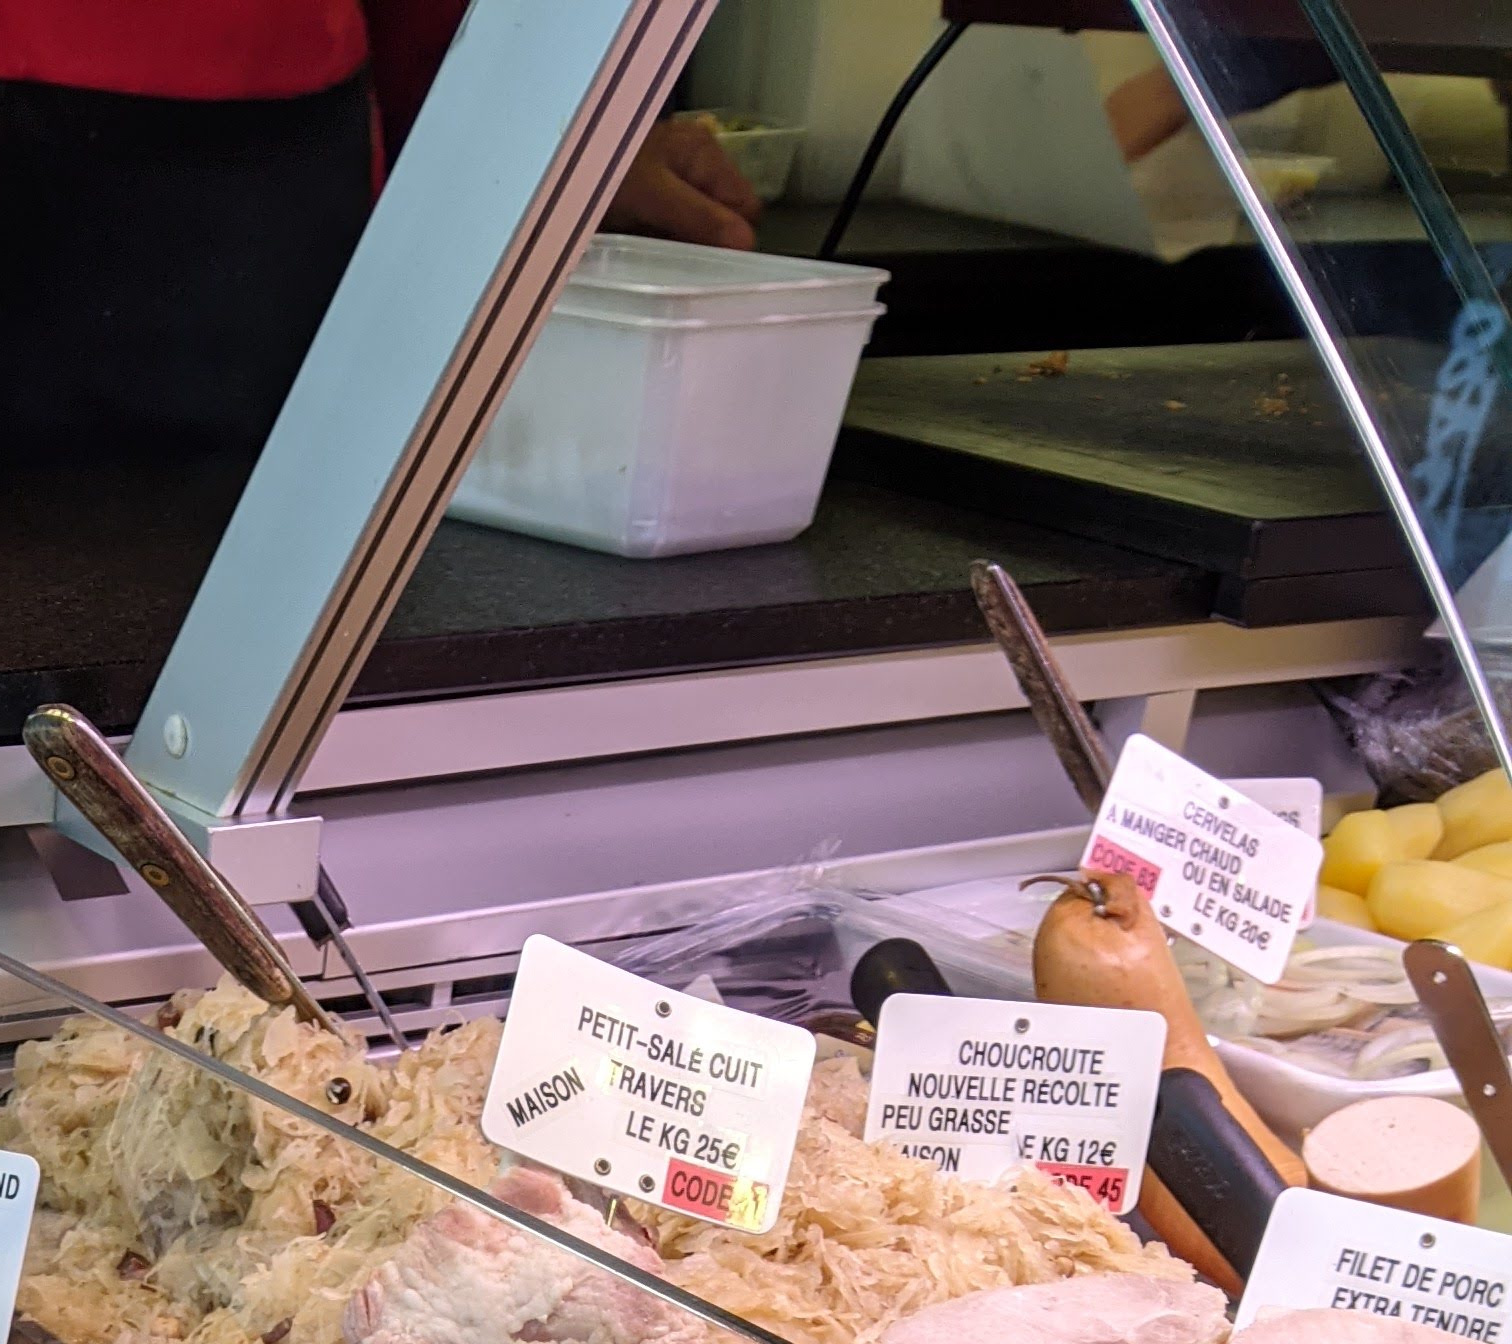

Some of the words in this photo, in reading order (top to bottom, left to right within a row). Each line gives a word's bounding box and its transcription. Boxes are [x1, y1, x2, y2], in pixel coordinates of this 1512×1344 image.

[1106, 804, 1117, 823] A
[1120, 809, 1187, 852] MANGER
[1189, 838, 1242, 875] CHAUD
[1183, 801, 1259, 857] CERVELAS
[1182, 861, 1206, 885] OU
[1208, 872, 1230, 897] EN
[1233, 882, 1292, 923] SALADE
[1193, 892, 1216, 918] LE
[1215, 906, 1239, 932] KG
[1238, 920, 1271, 950] 20€
[578, 1006, 704, 1073] PETIT-SALÉ
[709, 1052, 763, 1088] CUIT
[959, 1040, 1104, 1075] CHOUCROUTE
[506, 1066, 585, 1127] MAISON
[609, 1059, 707, 1117] TRAVERS
[908, 1073, 1016, 1102] NOUVELLE
[1022, 1078, 1120, 1108] RÉCOLTE
[625, 1111, 655, 1143] LE
[658, 1118, 690, 1154] KG
[693, 1134, 741, 1170] 25€
[881, 1104, 922, 1131] PEU
[928, 1106, 1011, 1135] GRASSE
[892, 1144, 961, 1172] AISON
[1040, 1136, 1069, 1162] KG
[1077, 1140, 1116, 1166] 12€
[670, 1170, 734, 1212] CODE
[1097, 1178, 1123, 1202] 45
[1331, 1287, 1402, 1317] EXTRA
[1335, 1248, 1400, 1284] FILET
[1401, 1263, 1436, 1293] DE
[1438, 1272, 1505, 1309] PORC
